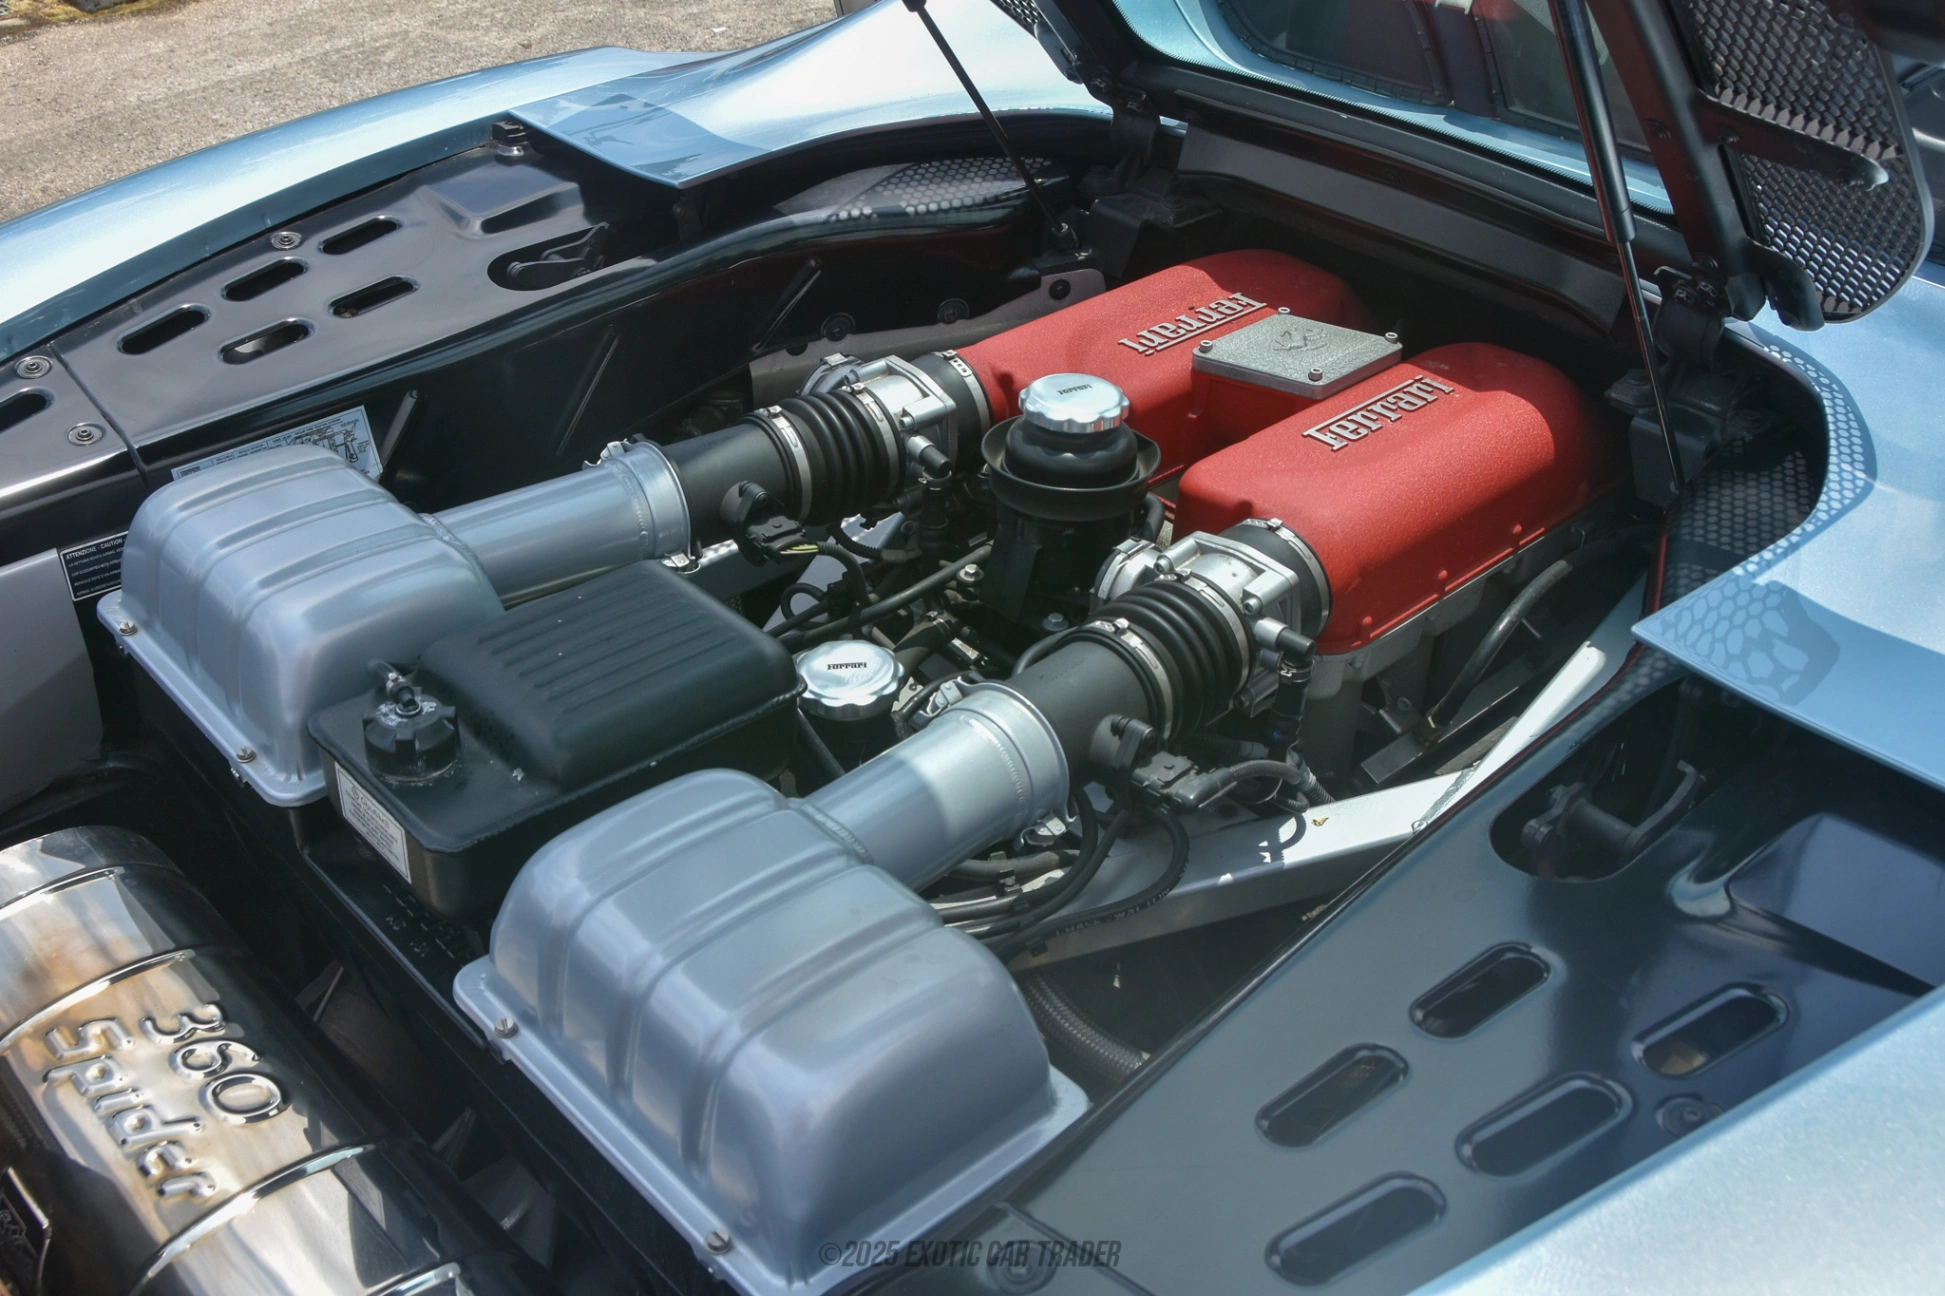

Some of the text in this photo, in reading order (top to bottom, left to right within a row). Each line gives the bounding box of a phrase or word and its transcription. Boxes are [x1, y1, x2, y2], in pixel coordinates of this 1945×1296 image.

[1118, 292, 1267, 356] Ferrari
[1302, 374, 1455, 451] Ferrari
[66, 538, 123, 560] ATTENZIONE CAUTION
[826, 661, 867, 671] Ferrari
[139, 1002, 290, 1125] 360
[43, 1016, 217, 1198] Spider
